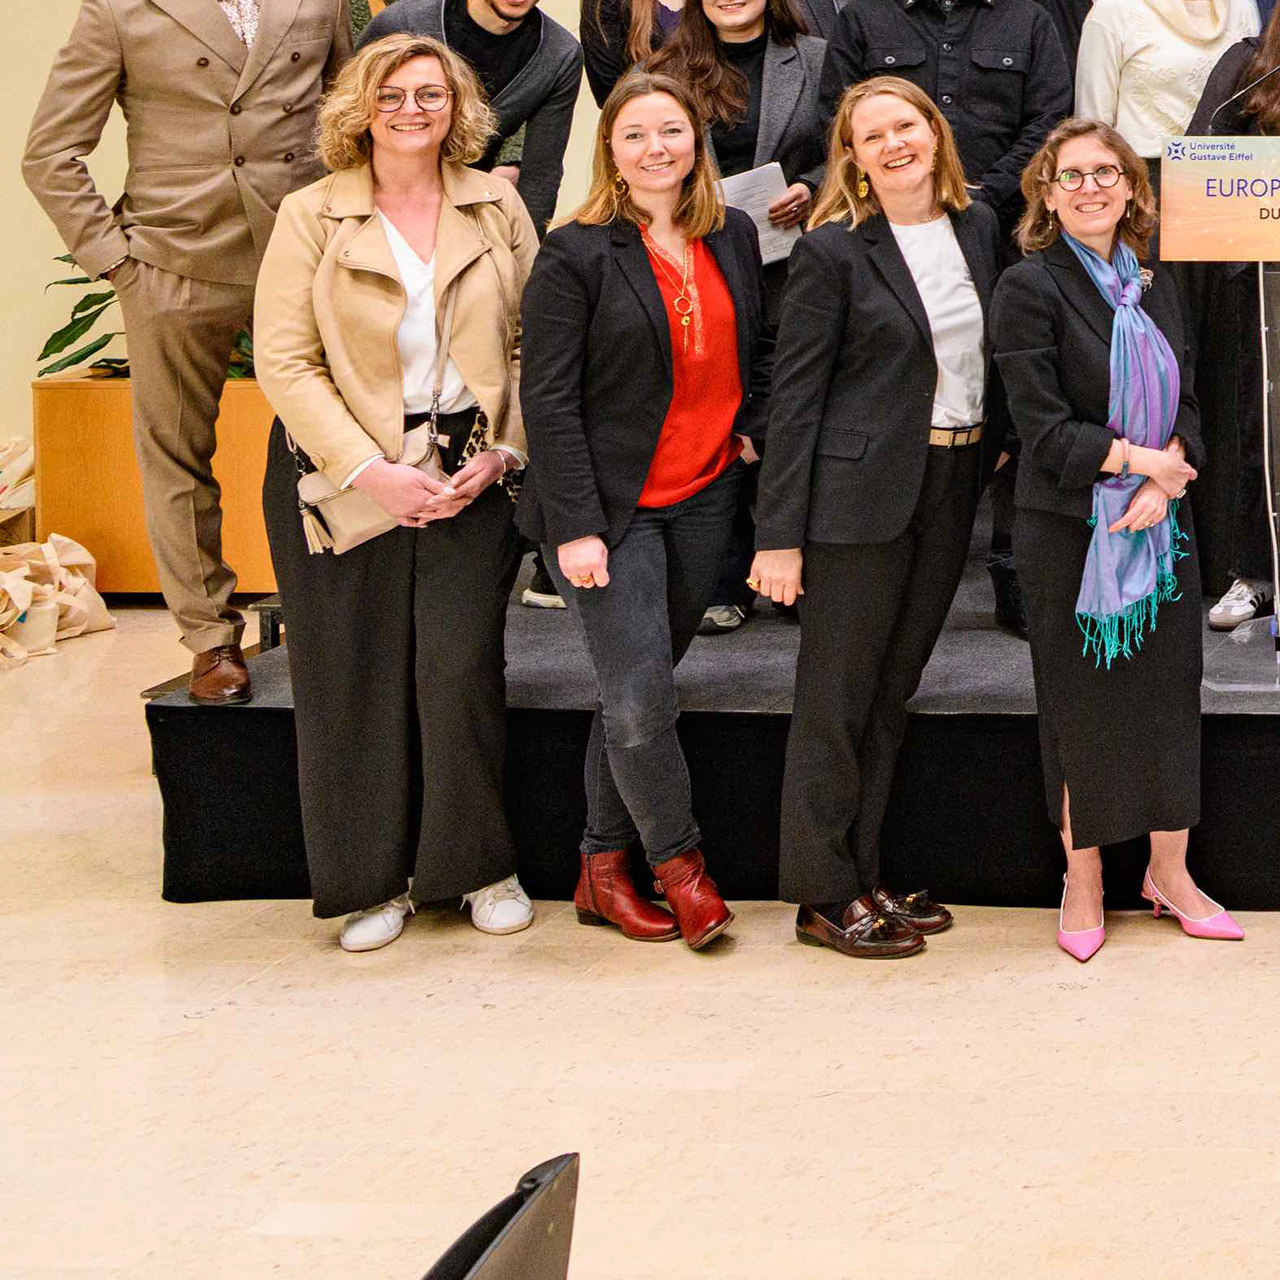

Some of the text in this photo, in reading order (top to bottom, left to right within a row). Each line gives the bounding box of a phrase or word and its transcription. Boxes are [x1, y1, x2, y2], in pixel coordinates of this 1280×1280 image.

[1189, 142, 1235, 151] Université
[1189, 153, 1253, 161] Gustave Eiffel
[1259, 208, 1280, 220] DU
